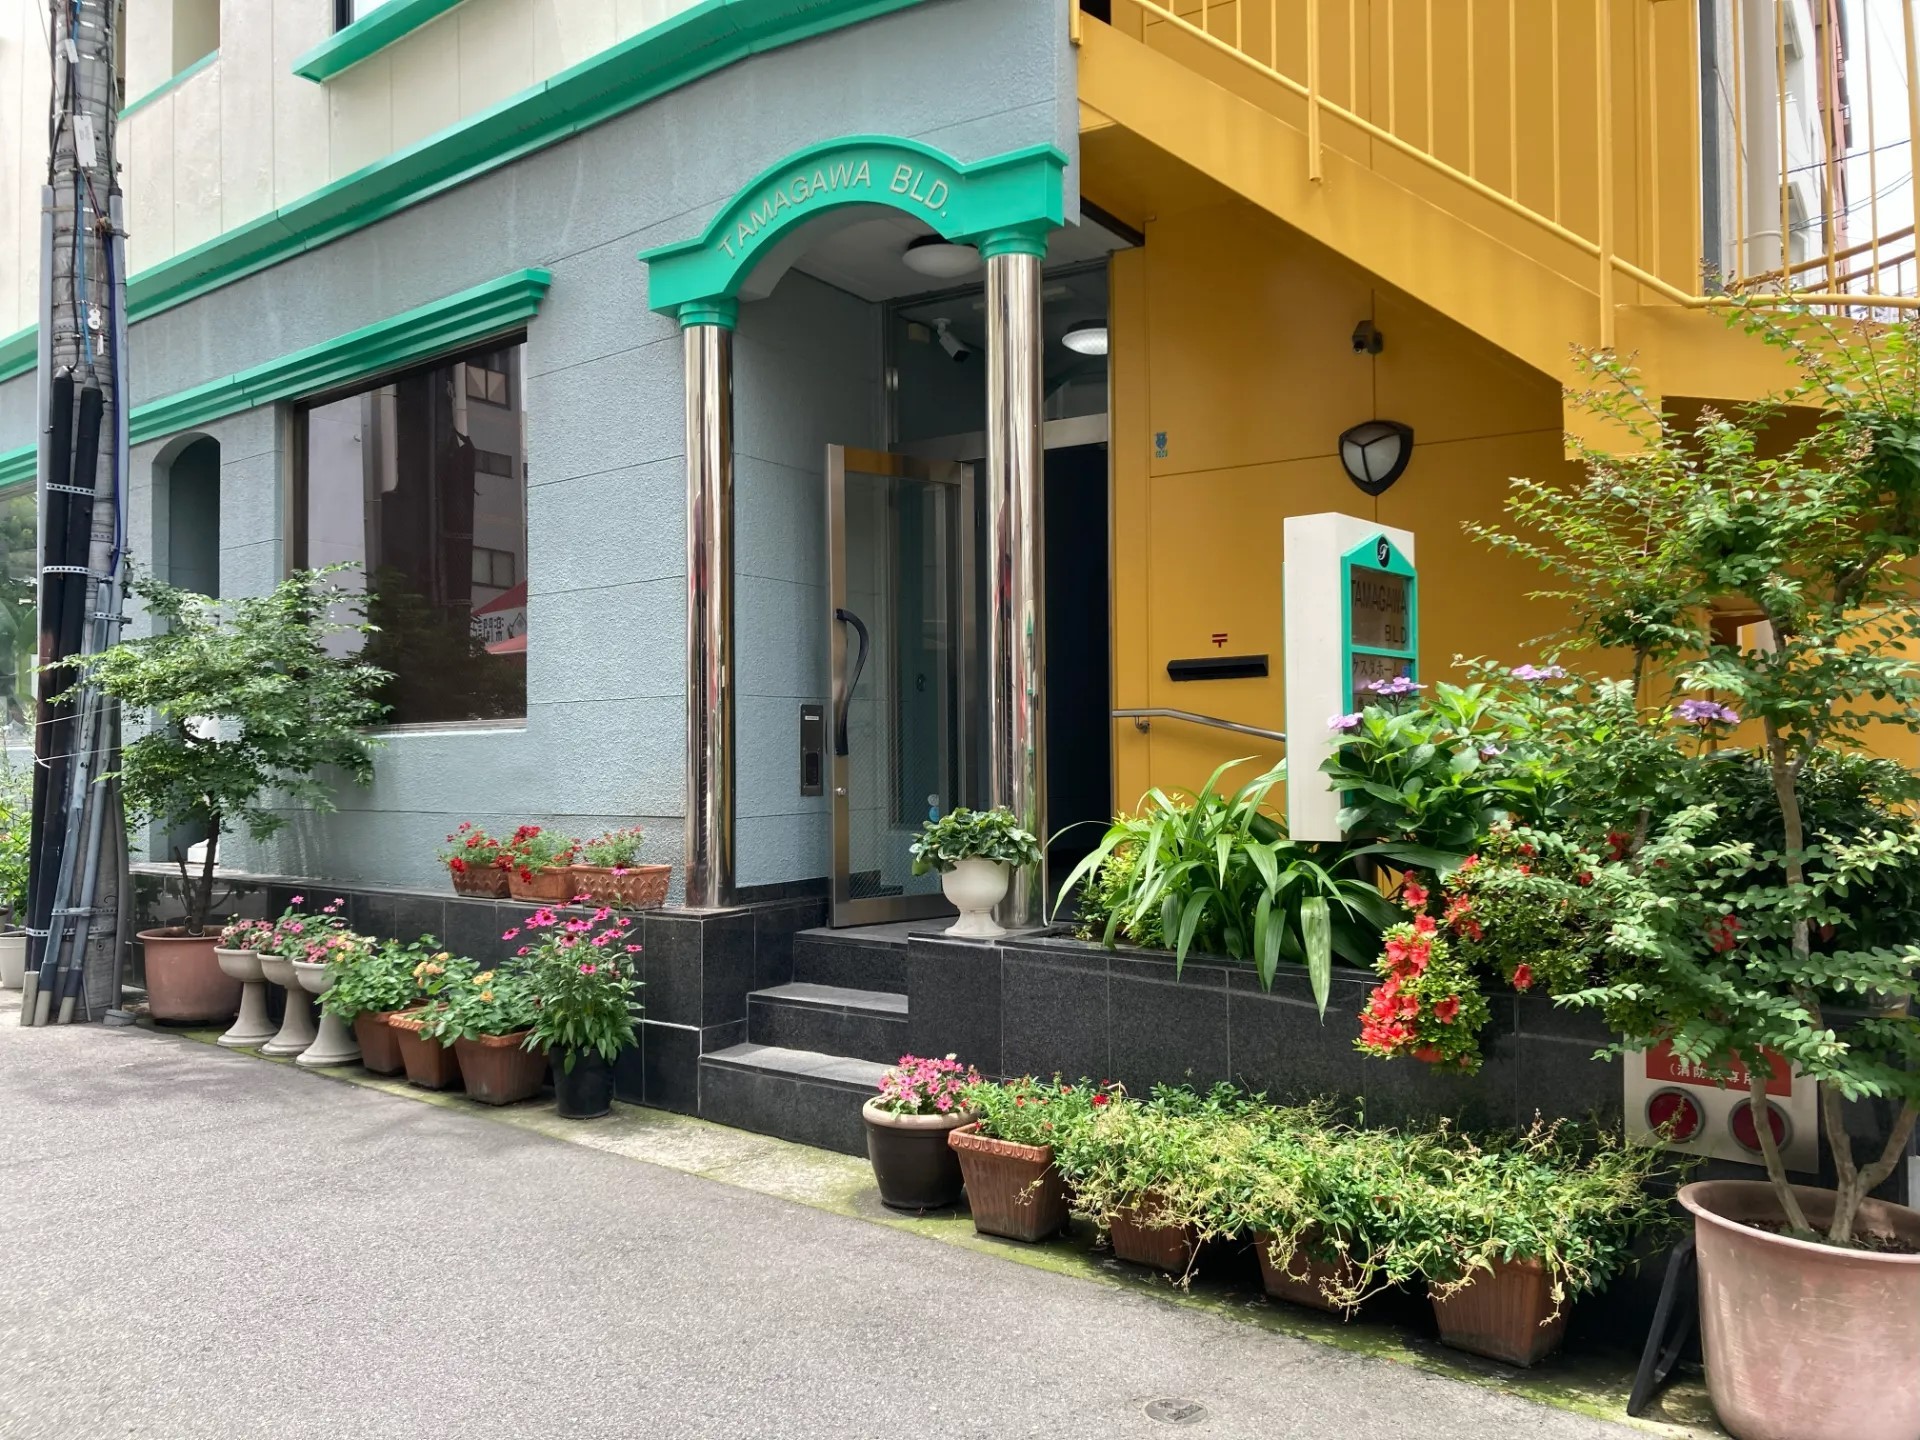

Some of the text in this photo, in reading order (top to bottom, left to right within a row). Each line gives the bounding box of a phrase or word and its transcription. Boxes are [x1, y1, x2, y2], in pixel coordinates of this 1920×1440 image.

[717, 159, 950, 259] TAMAGAWA BLD.
[1385, 624, 1408, 644] BLD
